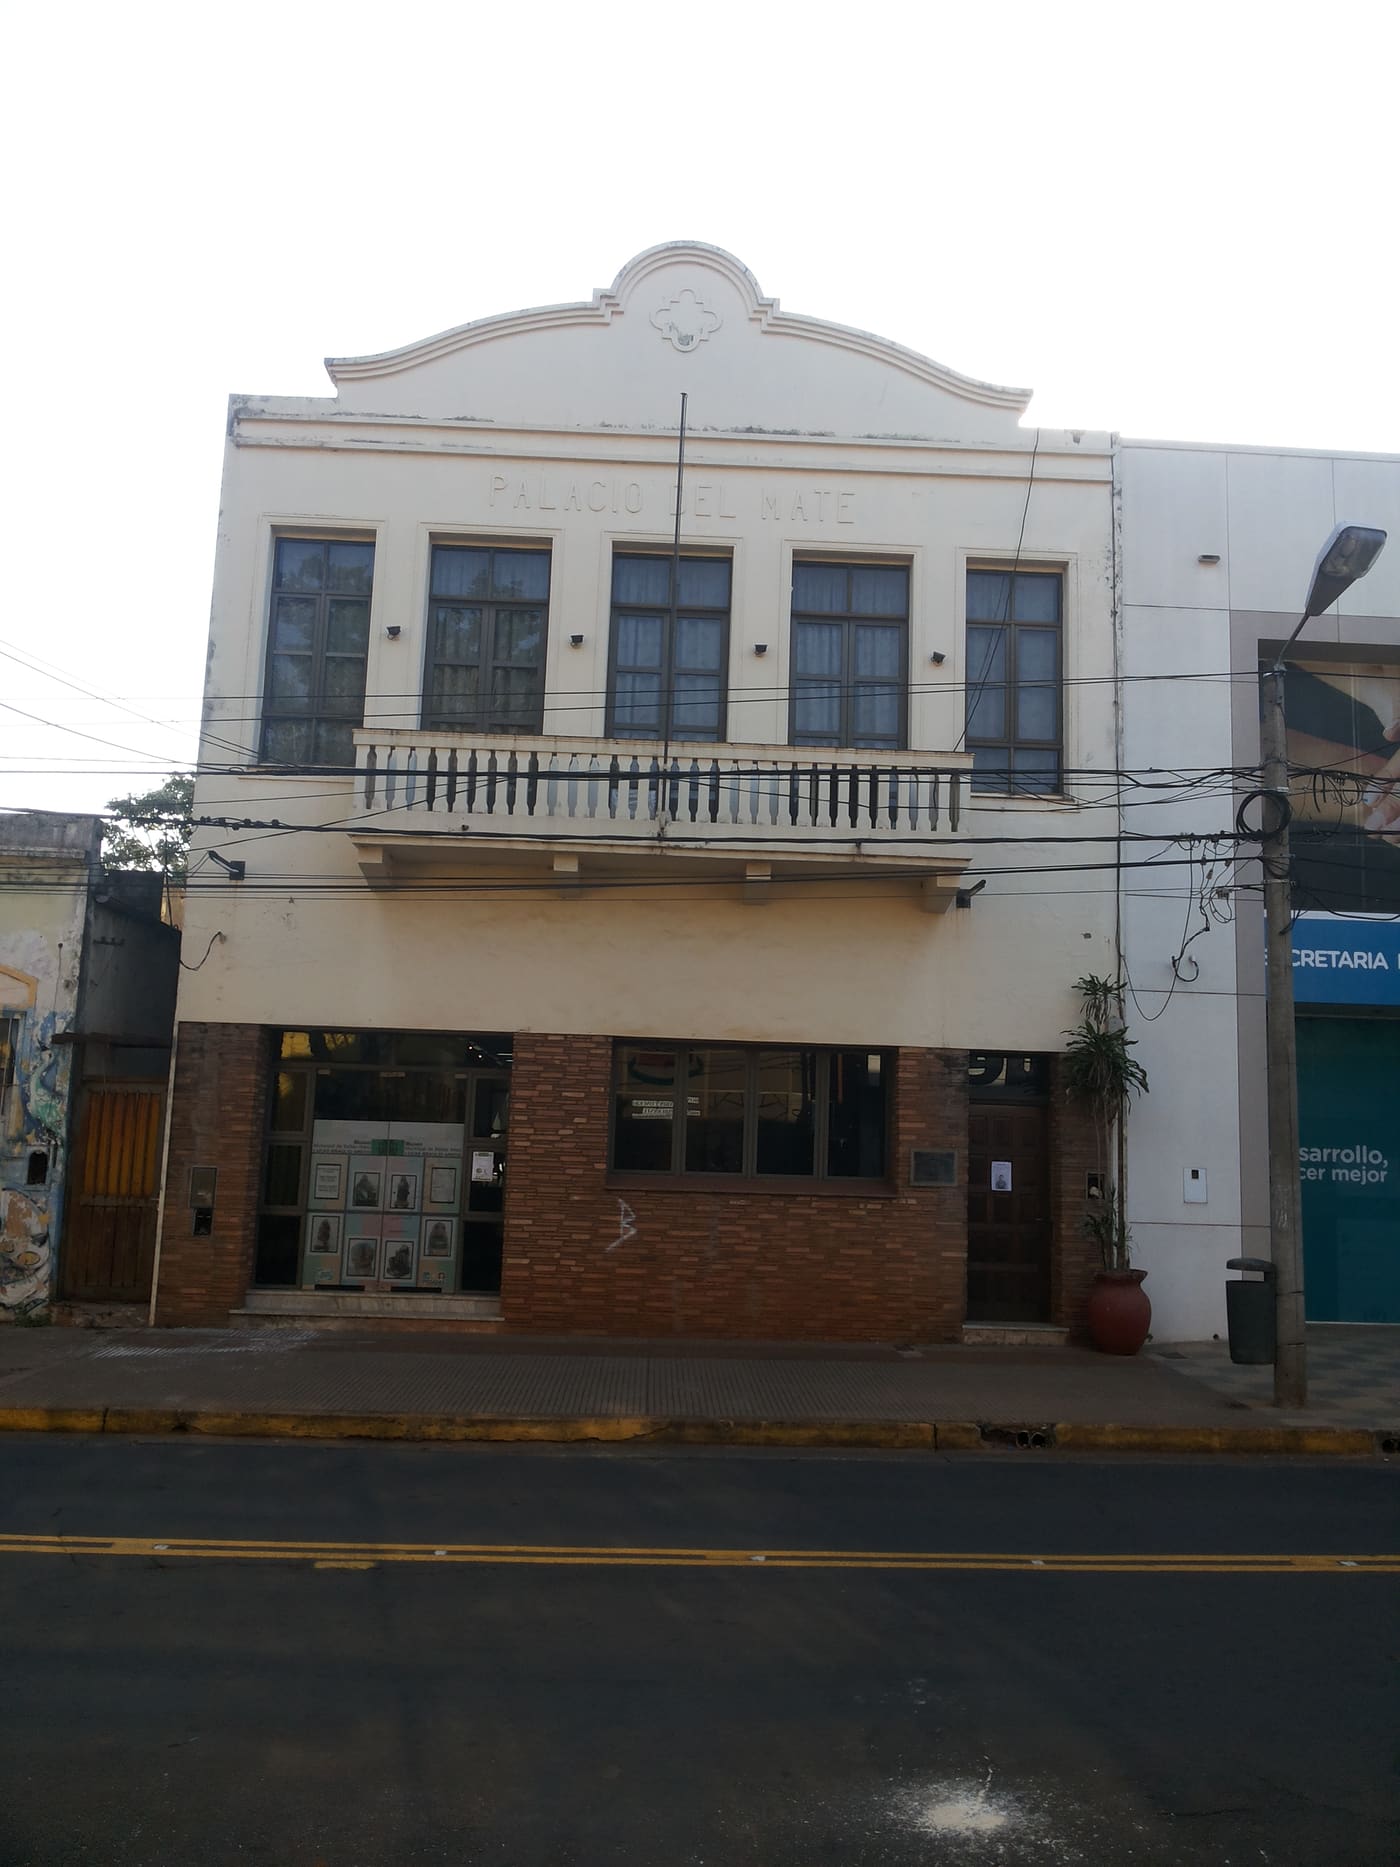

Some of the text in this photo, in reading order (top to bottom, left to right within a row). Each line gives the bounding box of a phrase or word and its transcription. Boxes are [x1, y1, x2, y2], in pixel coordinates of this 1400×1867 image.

[489, 475, 857, 525] PALACIO DEL MATE
[1290, 949, 1389, 970] CRETARIA
[1299, 1145, 1389, 1168] sarrollo,
[1299, 1166, 1388, 1185] cer mejor
